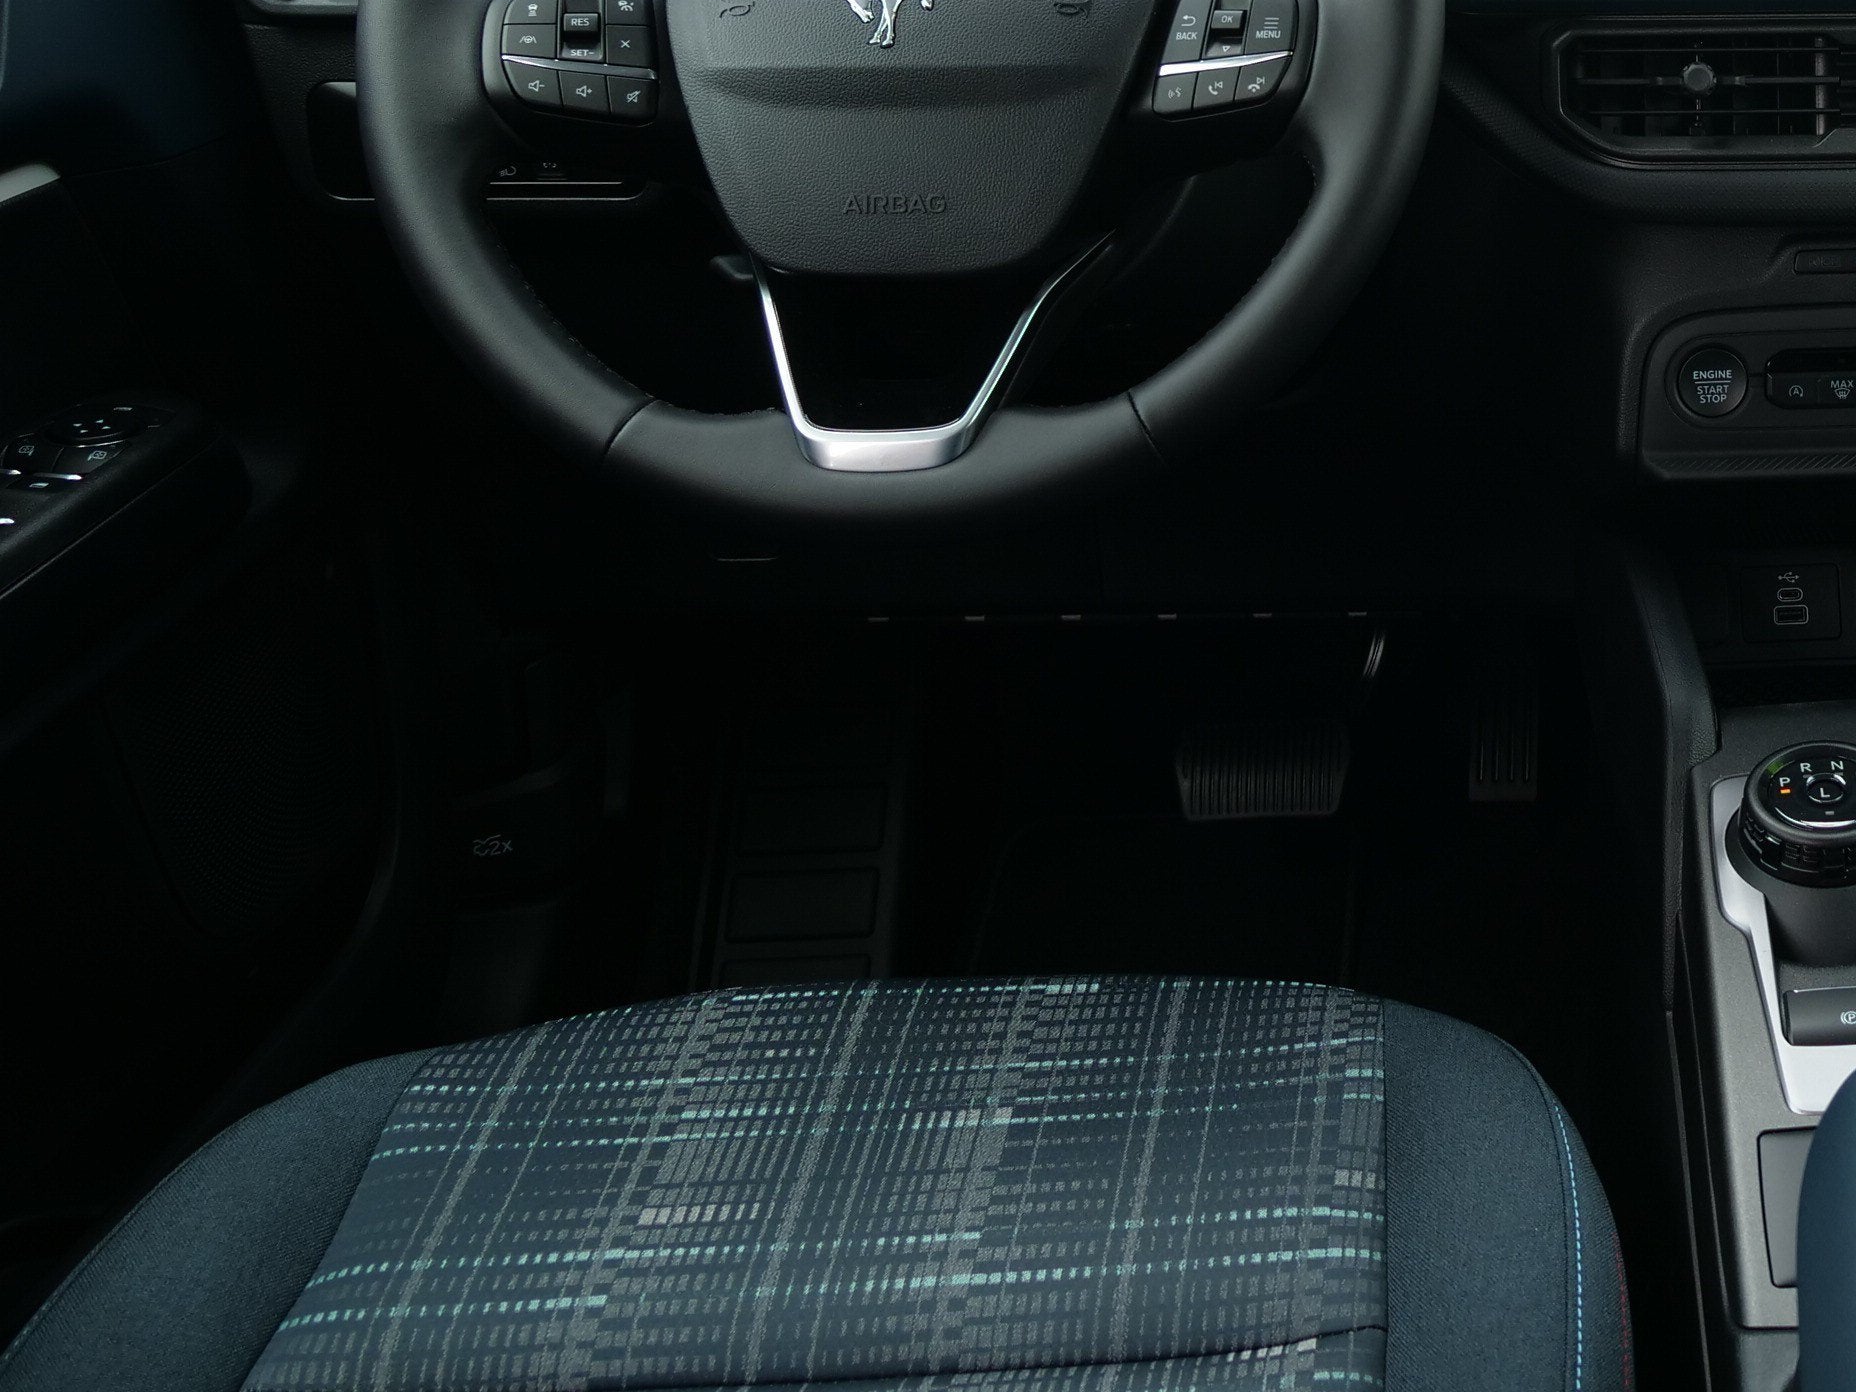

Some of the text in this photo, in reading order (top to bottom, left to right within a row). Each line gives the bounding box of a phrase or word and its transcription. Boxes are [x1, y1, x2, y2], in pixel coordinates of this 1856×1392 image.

[571, 18, 590, 26] RES
[1176, 32, 1198, 40] BACK
[1255, 30, 1281, 39] MENU
[843, 194, 947, 214] AIRBAG
[1693, 370, 1732, 379] ENGINE
[1830, 380, 1854, 388] MAX
[1697, 384, 1729, 395] START
[1700, 394, 1727, 403] STOP
[1780, 777, 1790, 787] P
[1800, 763, 1812, 772] R
[1831, 761, 1843, 770] N
[1820, 788, 1830, 798] L
